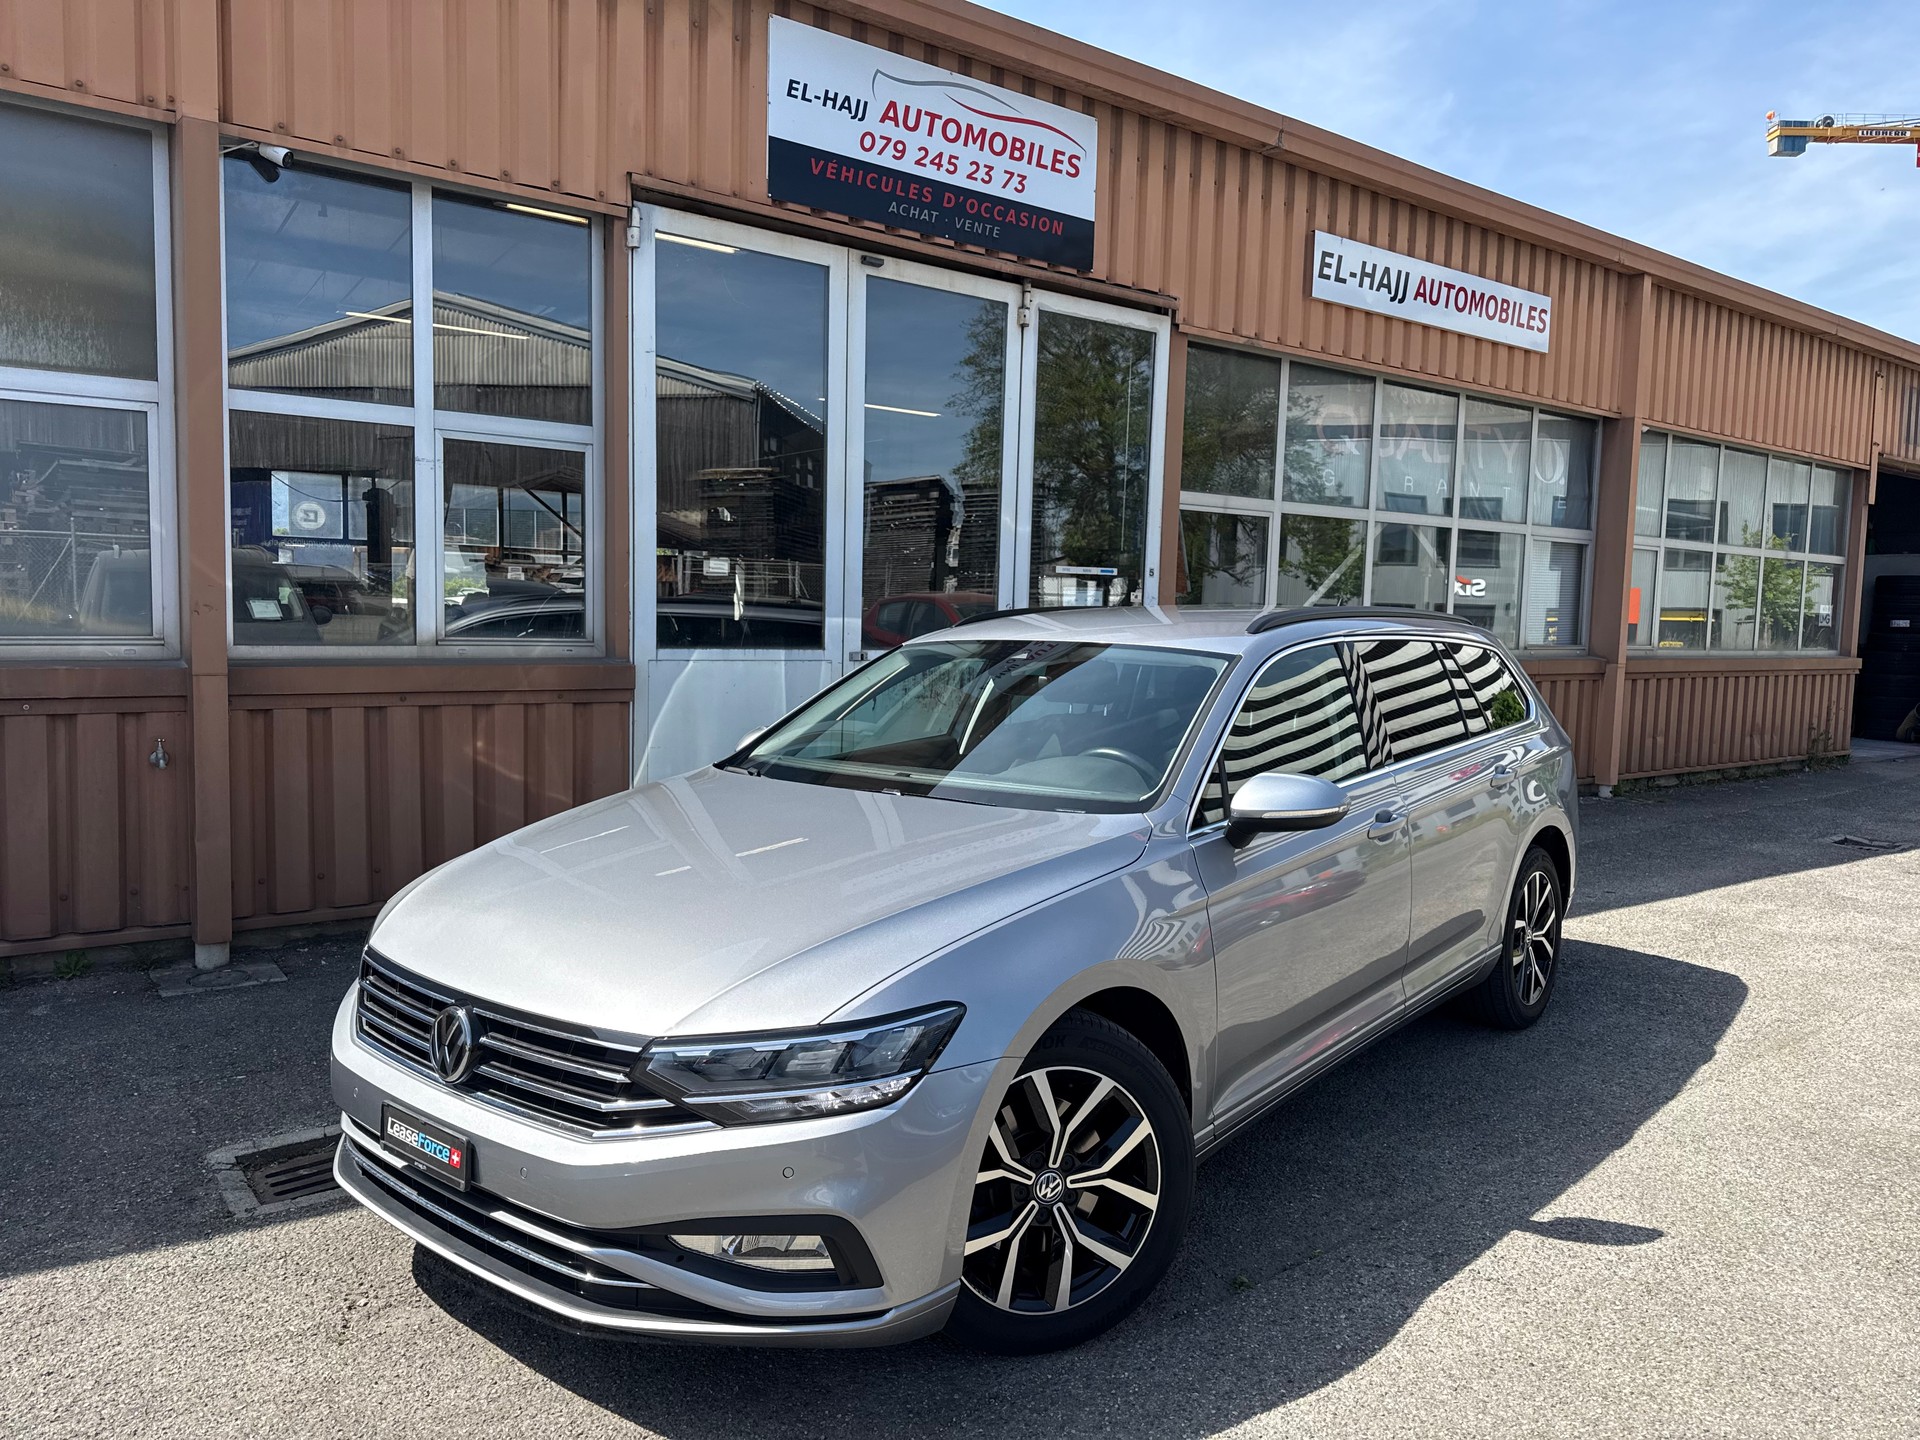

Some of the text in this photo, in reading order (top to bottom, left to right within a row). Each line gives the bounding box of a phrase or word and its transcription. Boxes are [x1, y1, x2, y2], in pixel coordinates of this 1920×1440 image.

[786, 78, 1081, 178] EL-HAJJ AUTOMOBILES
[859, 131, 1028, 194] 079 245 23 73
[809, 157, 1064, 235] VÉHICULES D'OCCASION
[888, 201, 1001, 239] ACHAT VENTE
[1317, 250, 1548, 334] EL-HAJJ AUTOMOBILES
[1149, 569, 1155, 577] 5
[387, 1116, 450, 1161] LeaseForce
